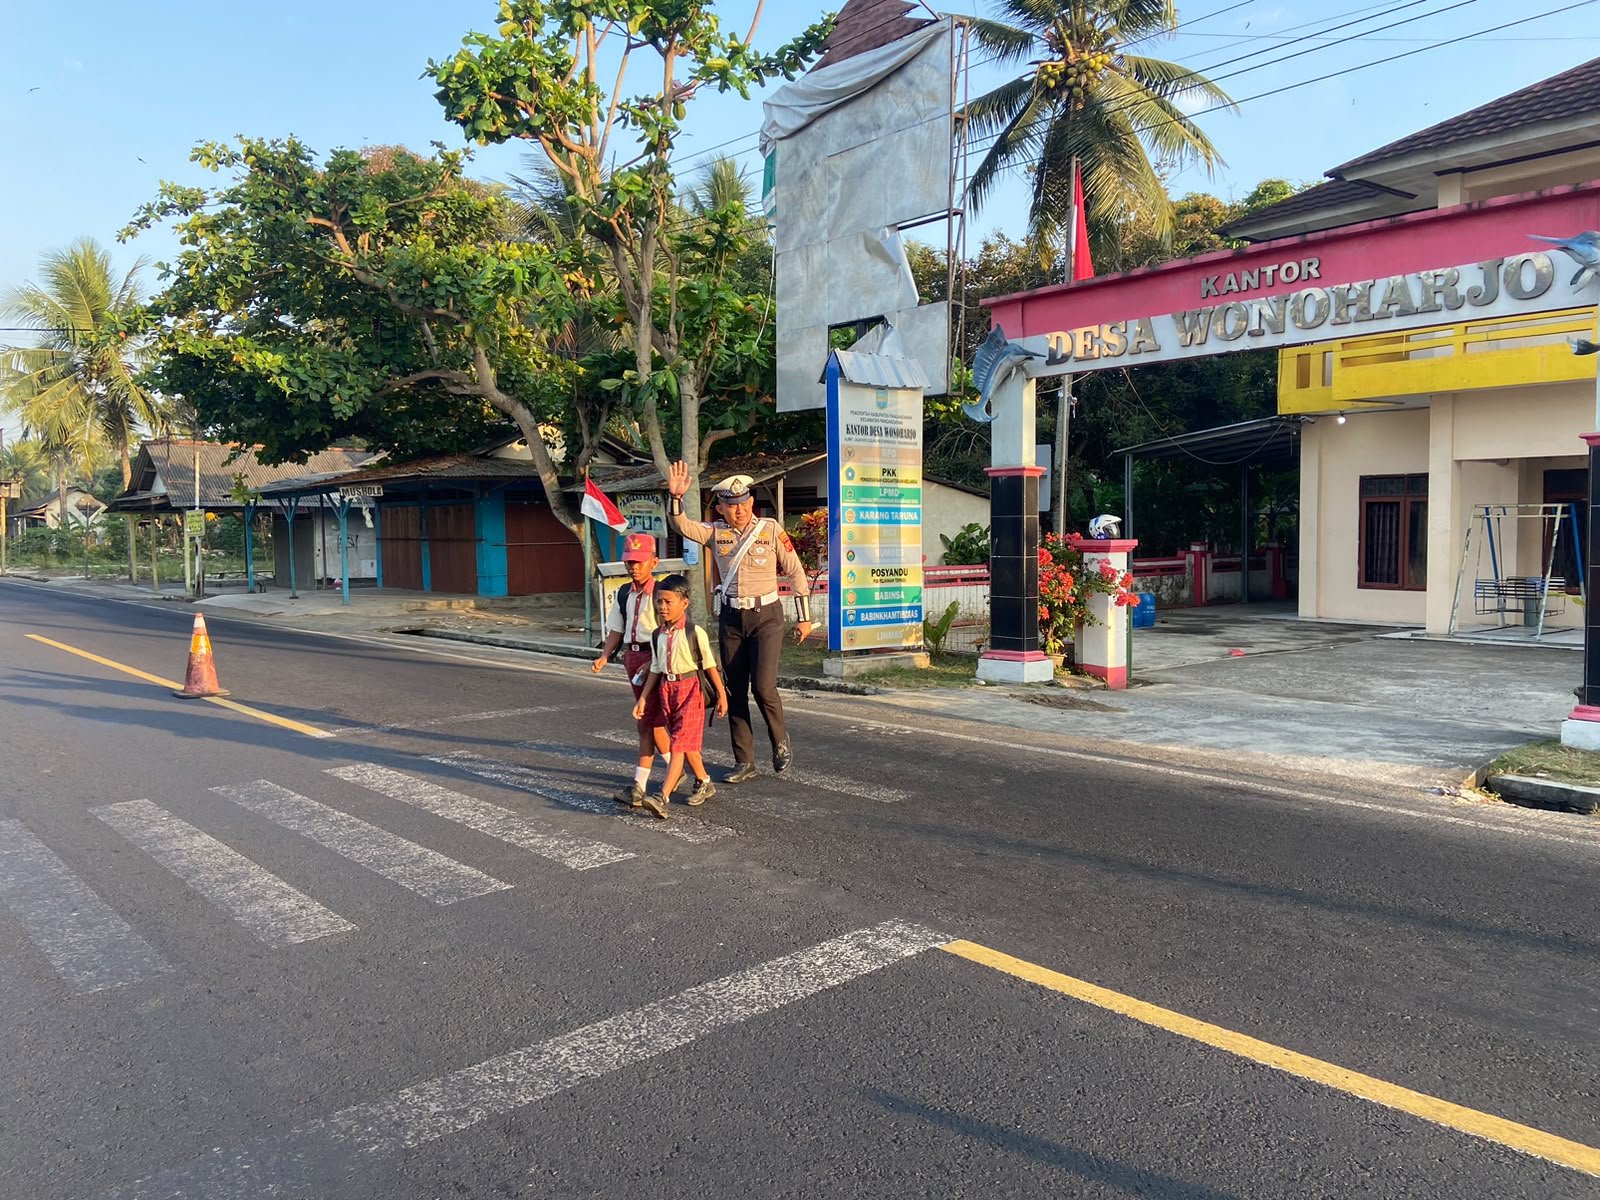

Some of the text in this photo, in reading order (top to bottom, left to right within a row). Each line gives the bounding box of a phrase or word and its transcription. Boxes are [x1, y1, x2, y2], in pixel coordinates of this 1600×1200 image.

[1201, 257, 1321, 298] KANTOR
[1045, 251, 1555, 366] DESA WONOHARJO
[846, 424, 917, 439] KANTOR DESA WONOHARJO
[882, 468, 897, 477] PKK
[880, 488, 899, 497] LPMD
[860, 511, 918, 520] KARANG TARUNA
[871, 568, 909, 577] POSYANDU
[874, 591, 905, 600] BABINSA
